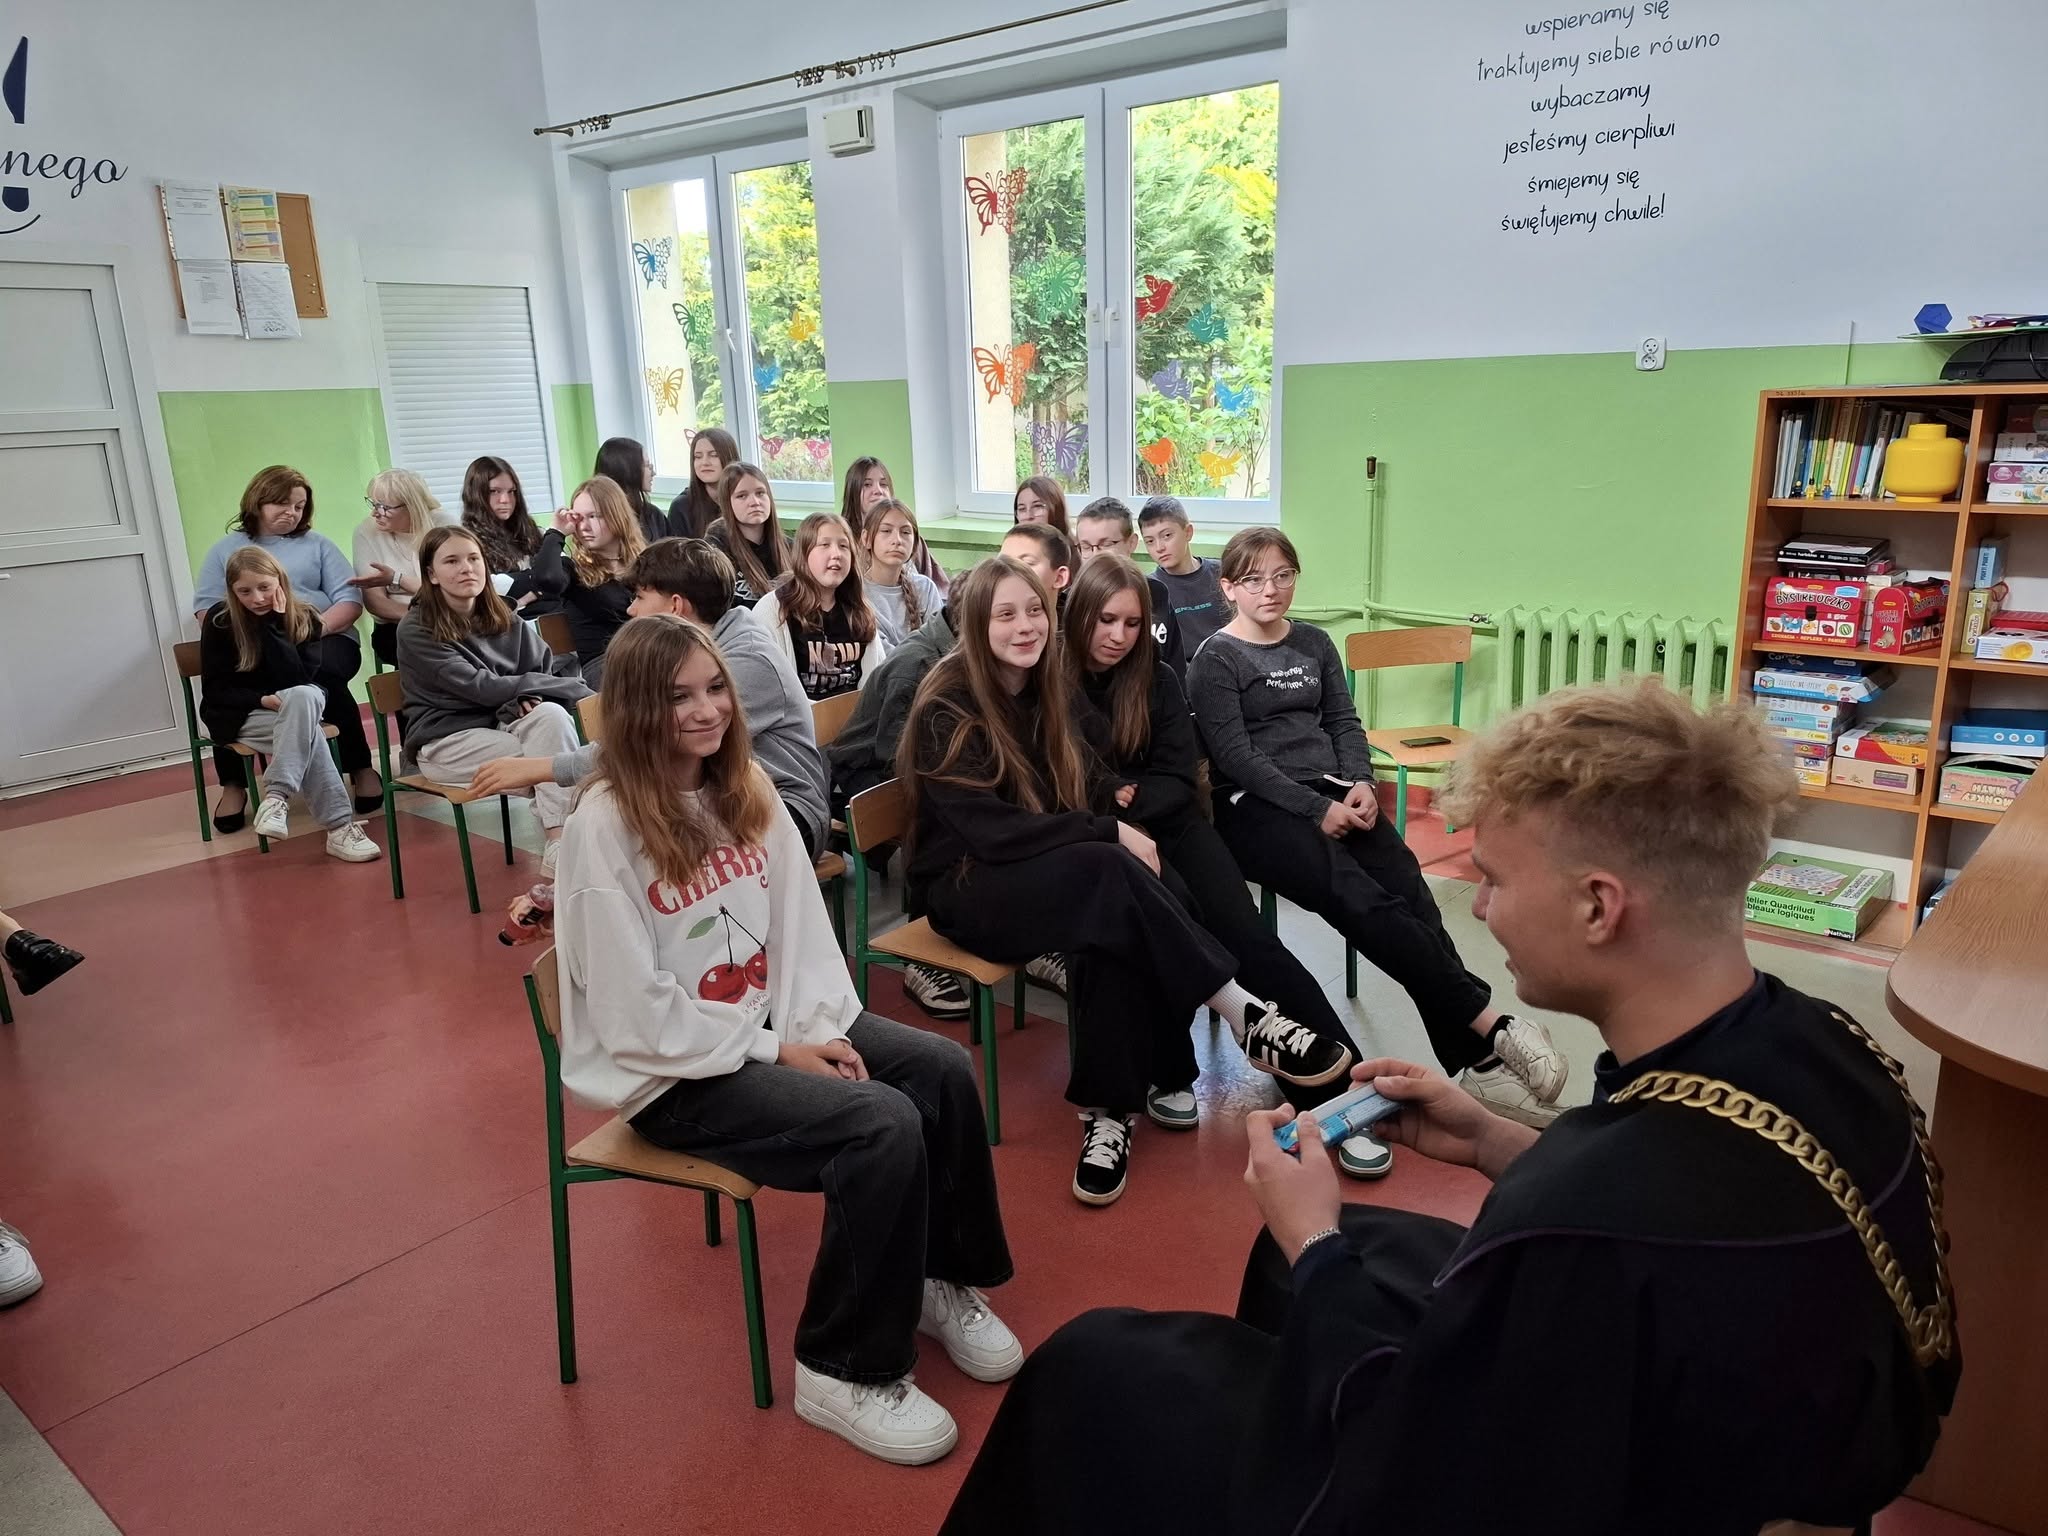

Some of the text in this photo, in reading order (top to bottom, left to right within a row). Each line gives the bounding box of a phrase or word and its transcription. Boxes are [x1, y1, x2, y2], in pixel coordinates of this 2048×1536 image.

[1526, 0, 1669, 40] wspieramy się
[1478, 34, 1719, 82] traktujemy siebie równo
[1531, 84, 1650, 119] wybaczamy
[1503, 113, 1675, 164] jesteśmy cierpliwi
[0, 151, 128, 199] nego
[1528, 168, 1640, 198] śmiejemy się
[1502, 193, 1665, 235] świętujemy chwile!
[1776, 592, 1851, 611] BYSTRE OCZKO
[807, 641, 861, 674] NEW
[1971, 783, 2008, 796] MATH
[1747, 896, 1768, 905] telier
[1770, 900, 1816, 915] Quadriludi
[1747, 902, 1815, 922] bleaux logiques
